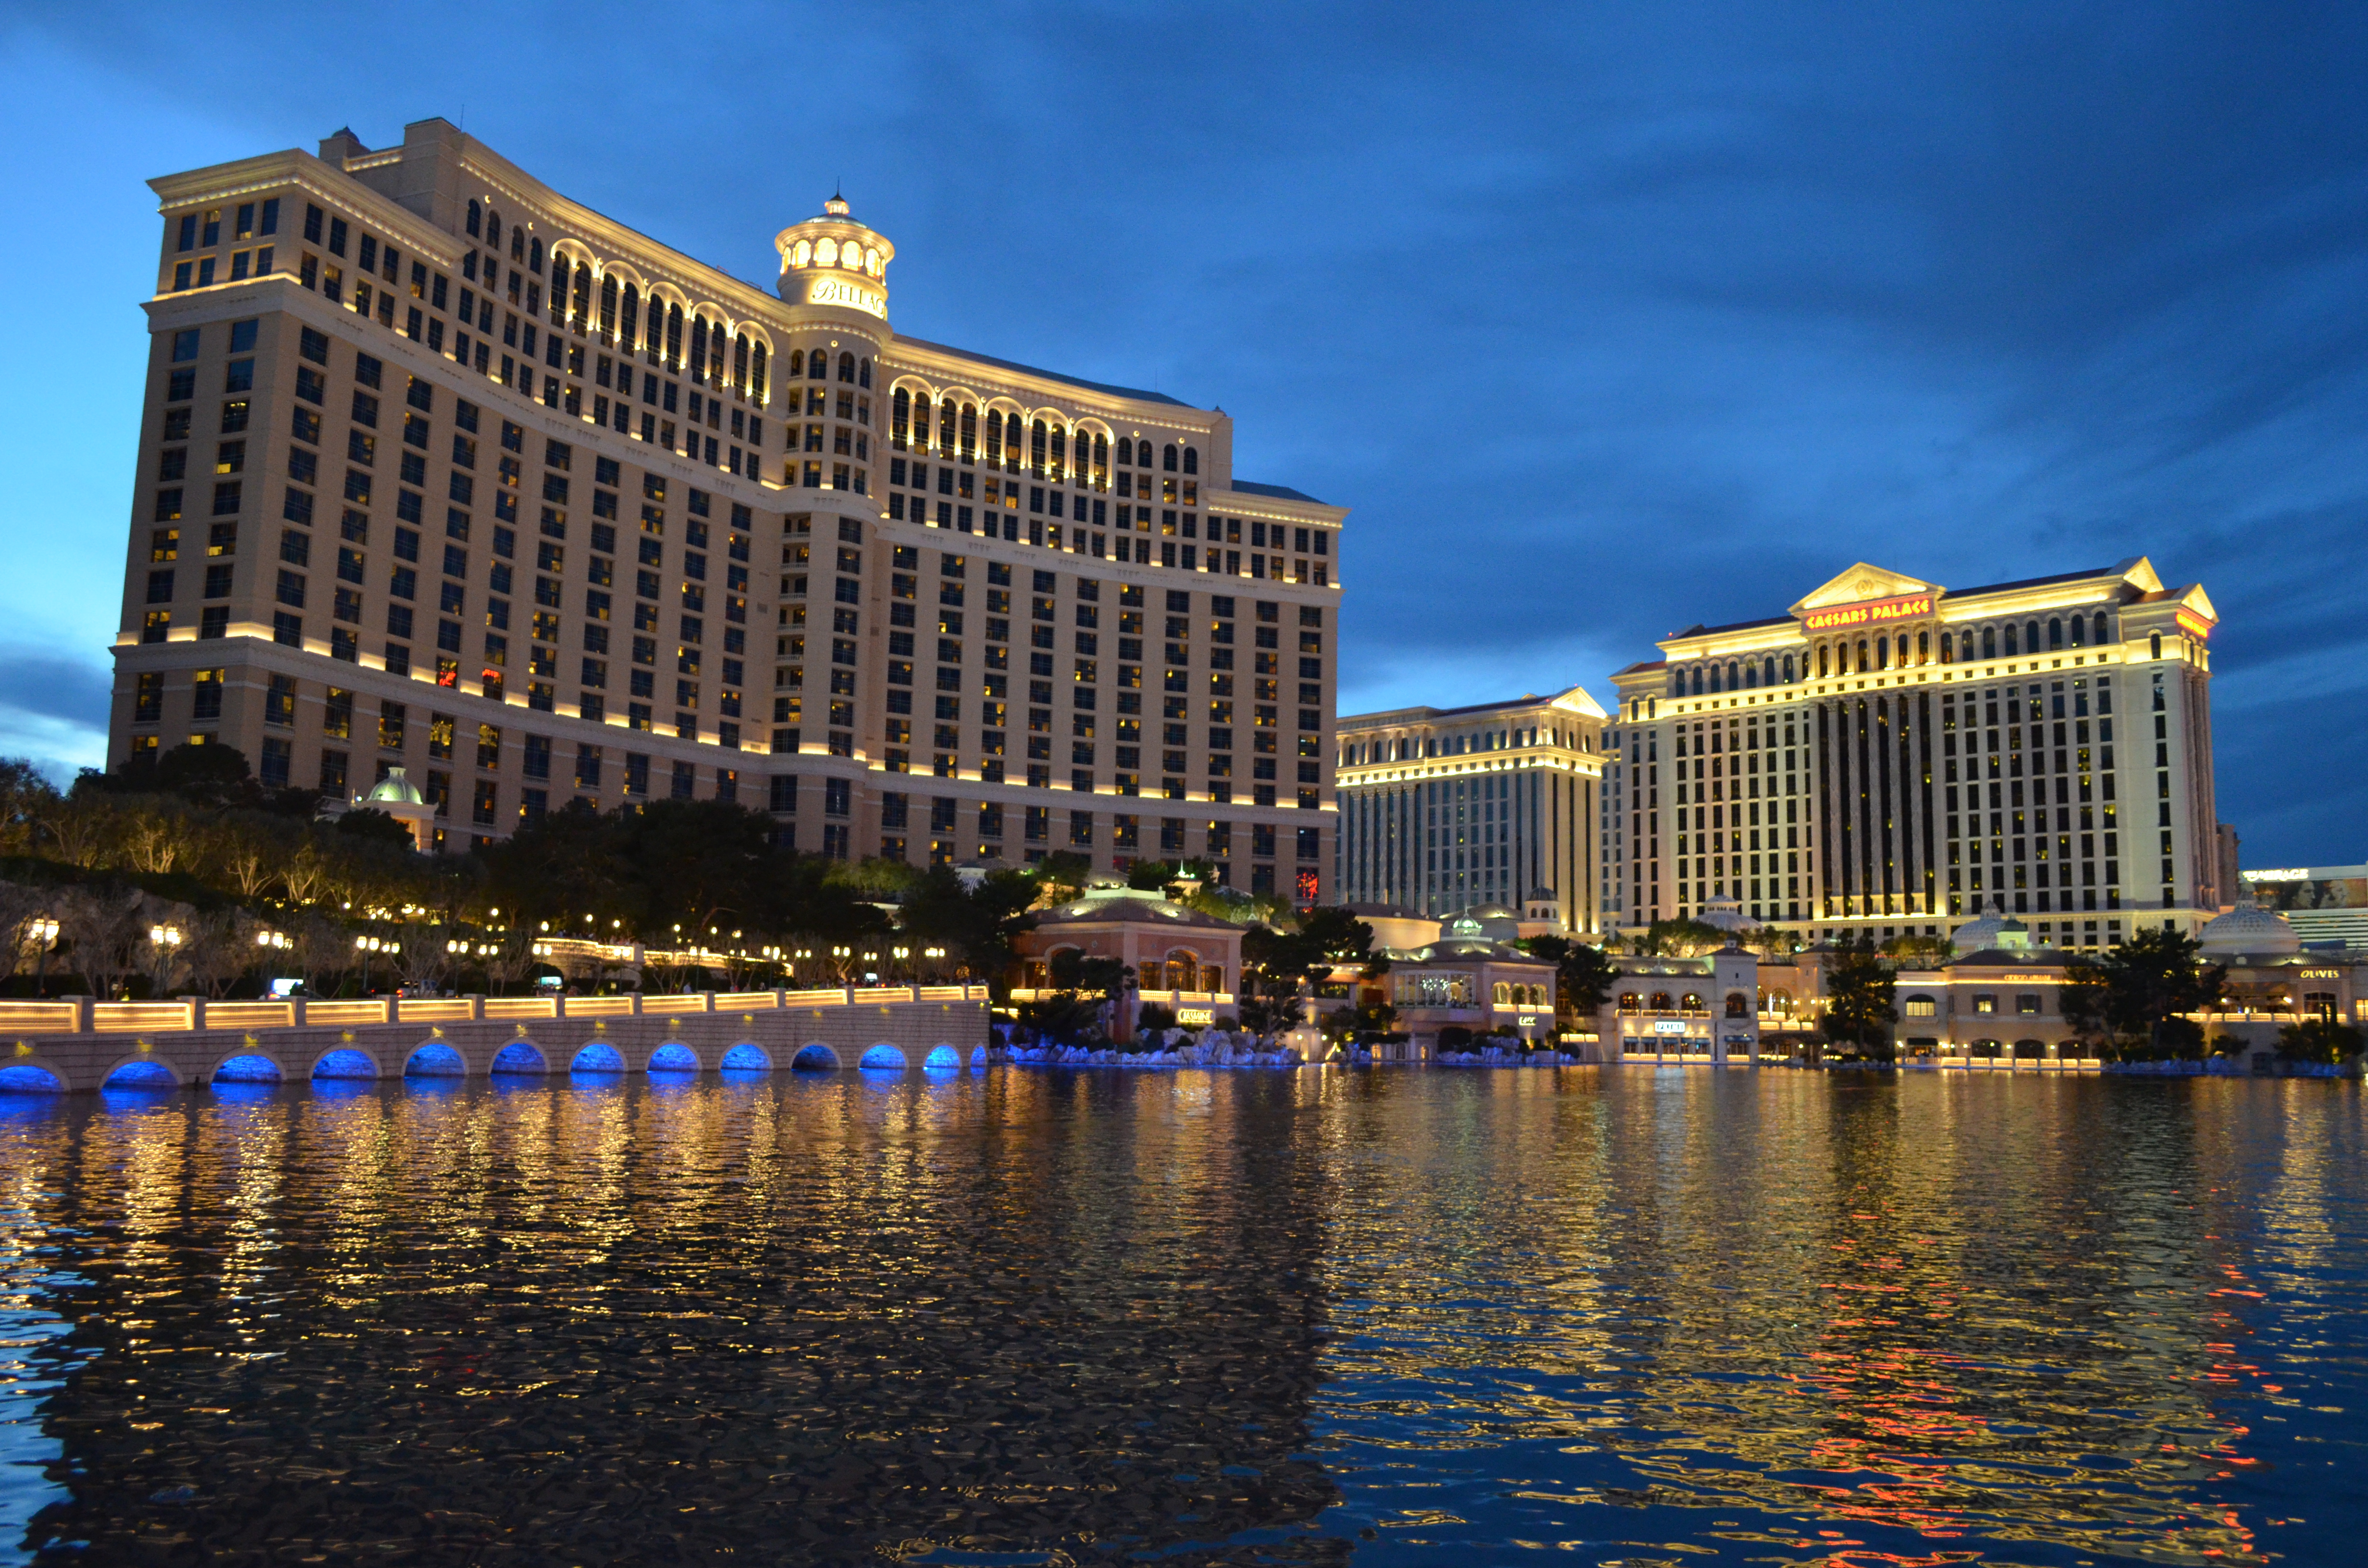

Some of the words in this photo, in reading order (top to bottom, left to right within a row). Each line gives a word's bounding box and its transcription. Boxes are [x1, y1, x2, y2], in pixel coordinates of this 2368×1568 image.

[1806, 608, 1868, 629] CAESARS
[1872, 599, 1929, 620] PALACE
[2257, 869, 2308, 881] MIRAGE
[2300, 969, 2339, 978] OLIVES
